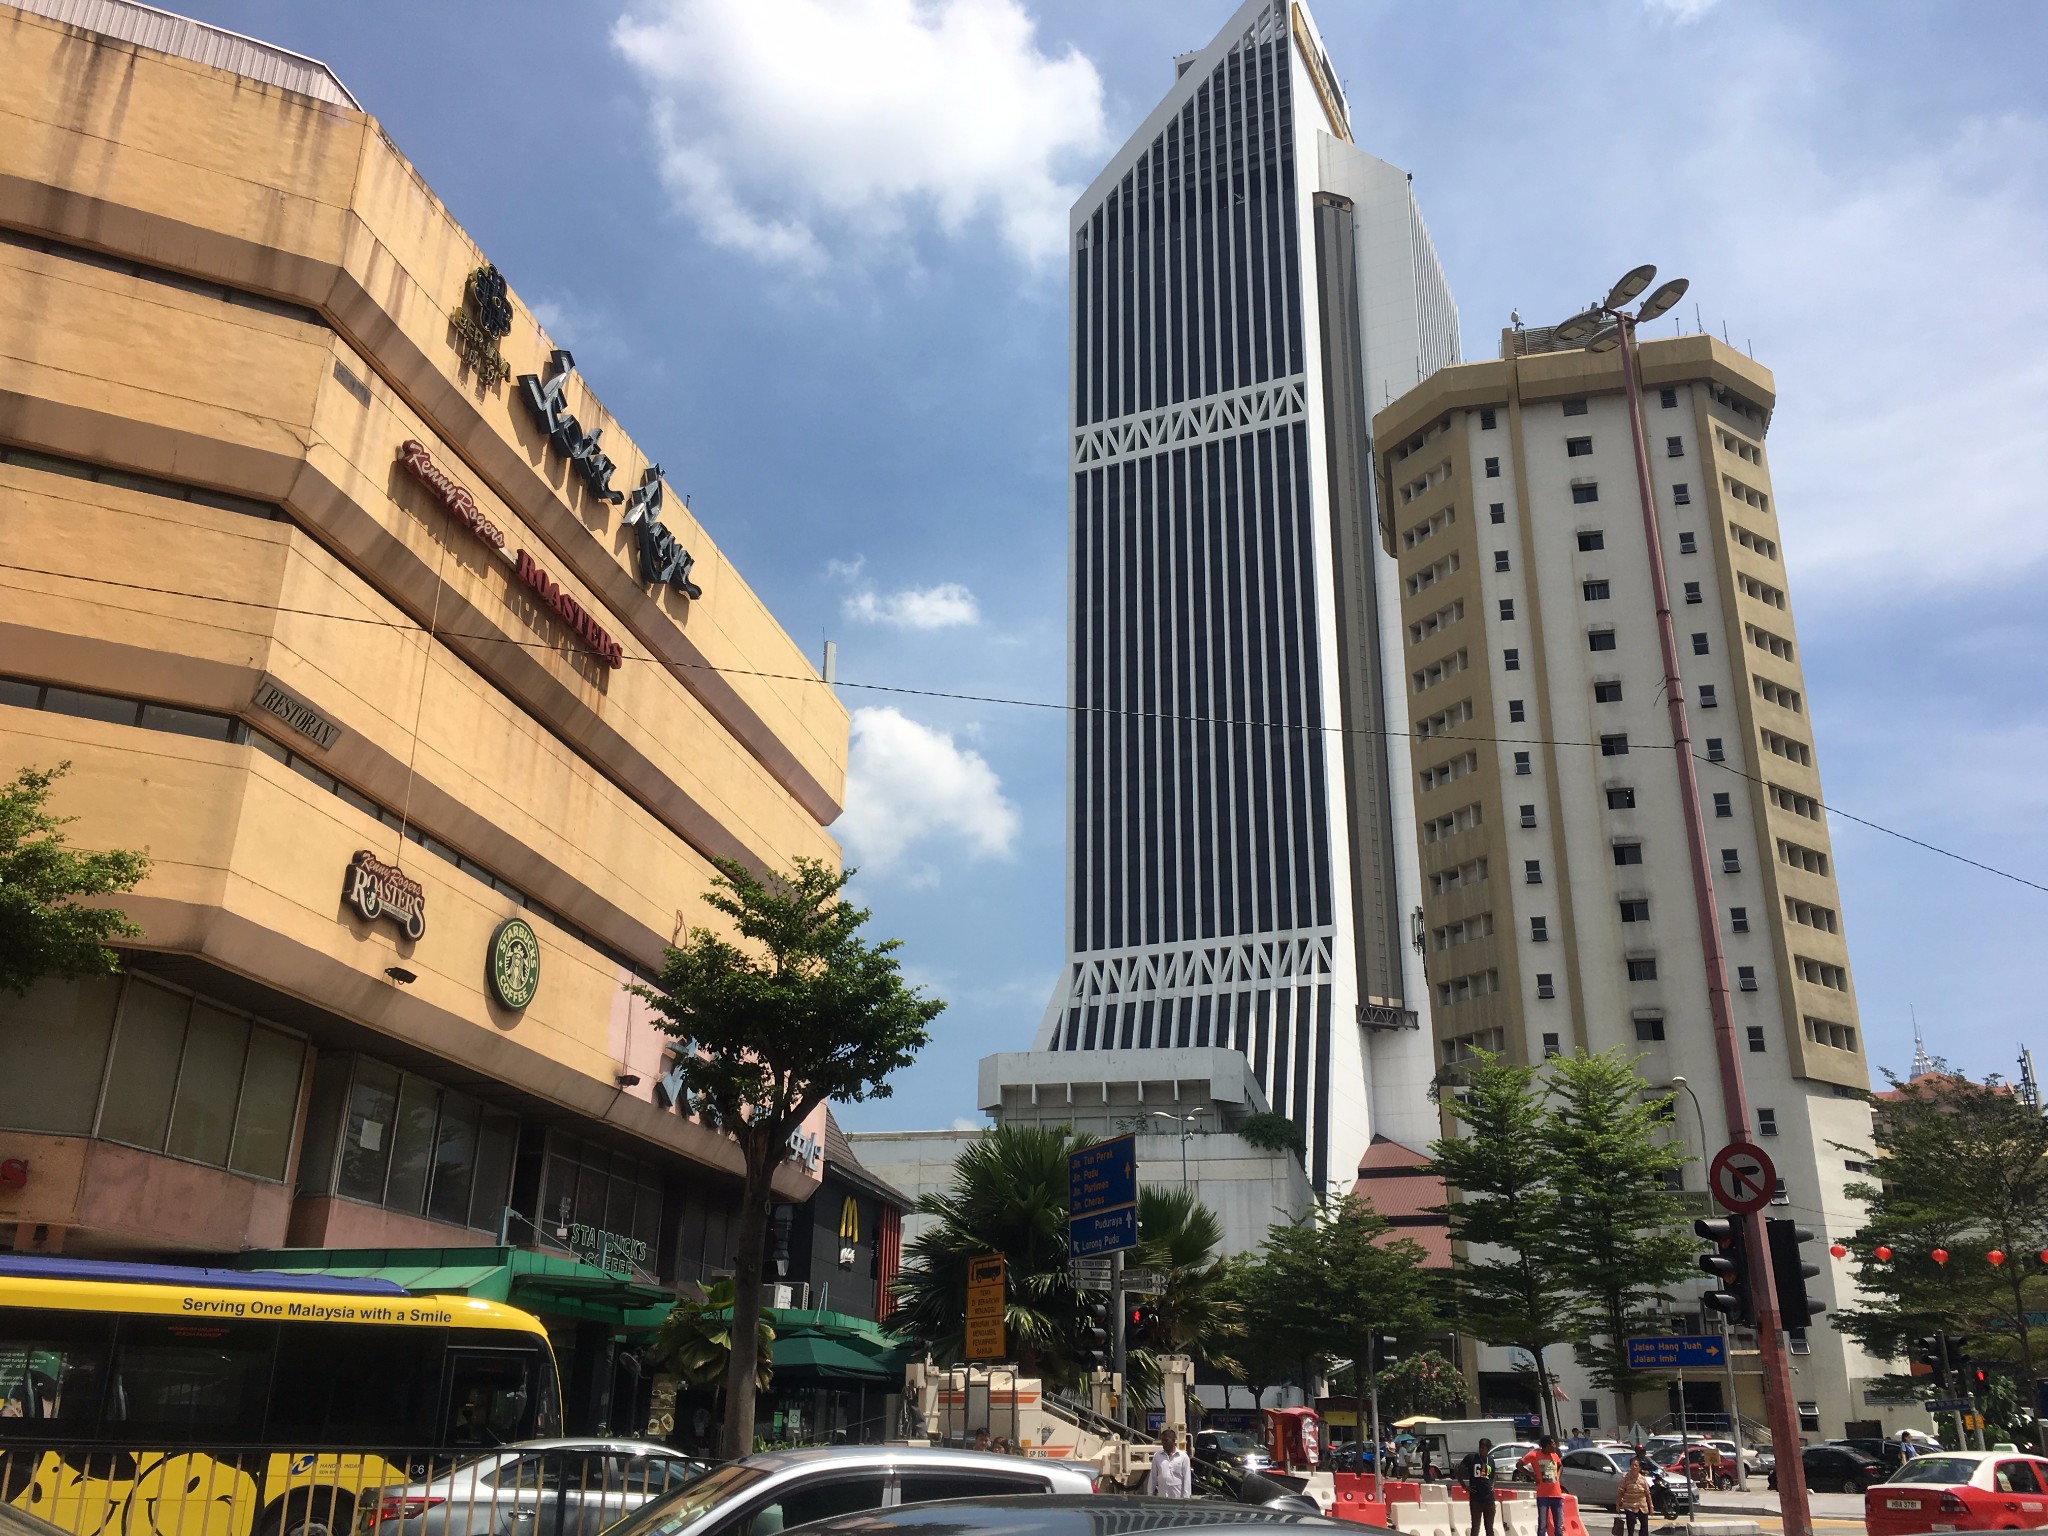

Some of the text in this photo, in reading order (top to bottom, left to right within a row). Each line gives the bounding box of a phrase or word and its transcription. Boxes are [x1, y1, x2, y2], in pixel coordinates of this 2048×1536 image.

[408, 442, 505, 548] Kenny Rogers
[516, 548, 623, 670] ROASTERS
[262, 689, 334, 744] RESTORAN
[361, 852, 421, 896] Kenny Rogers
[350, 867, 424, 938] ROASTERS
[500, 926, 537, 969] STARBUCKS
[500, 975, 528, 1003] COFFEE
[1084, 1169, 1099, 1179] Pudu
[1094, 1217, 1123, 1230] Puduraya
[1081, 1233, 1120, 1251] Lorong Pudu
[586, 1252, 633, 1275] CFFEE
[182, 1297, 452, 1323] Serving One Malaysia with a Smile
[1633, 1341, 1702, 1352] Jalan Hang Tuah
[1634, 1354, 1677, 1363] Jalan Imbi
